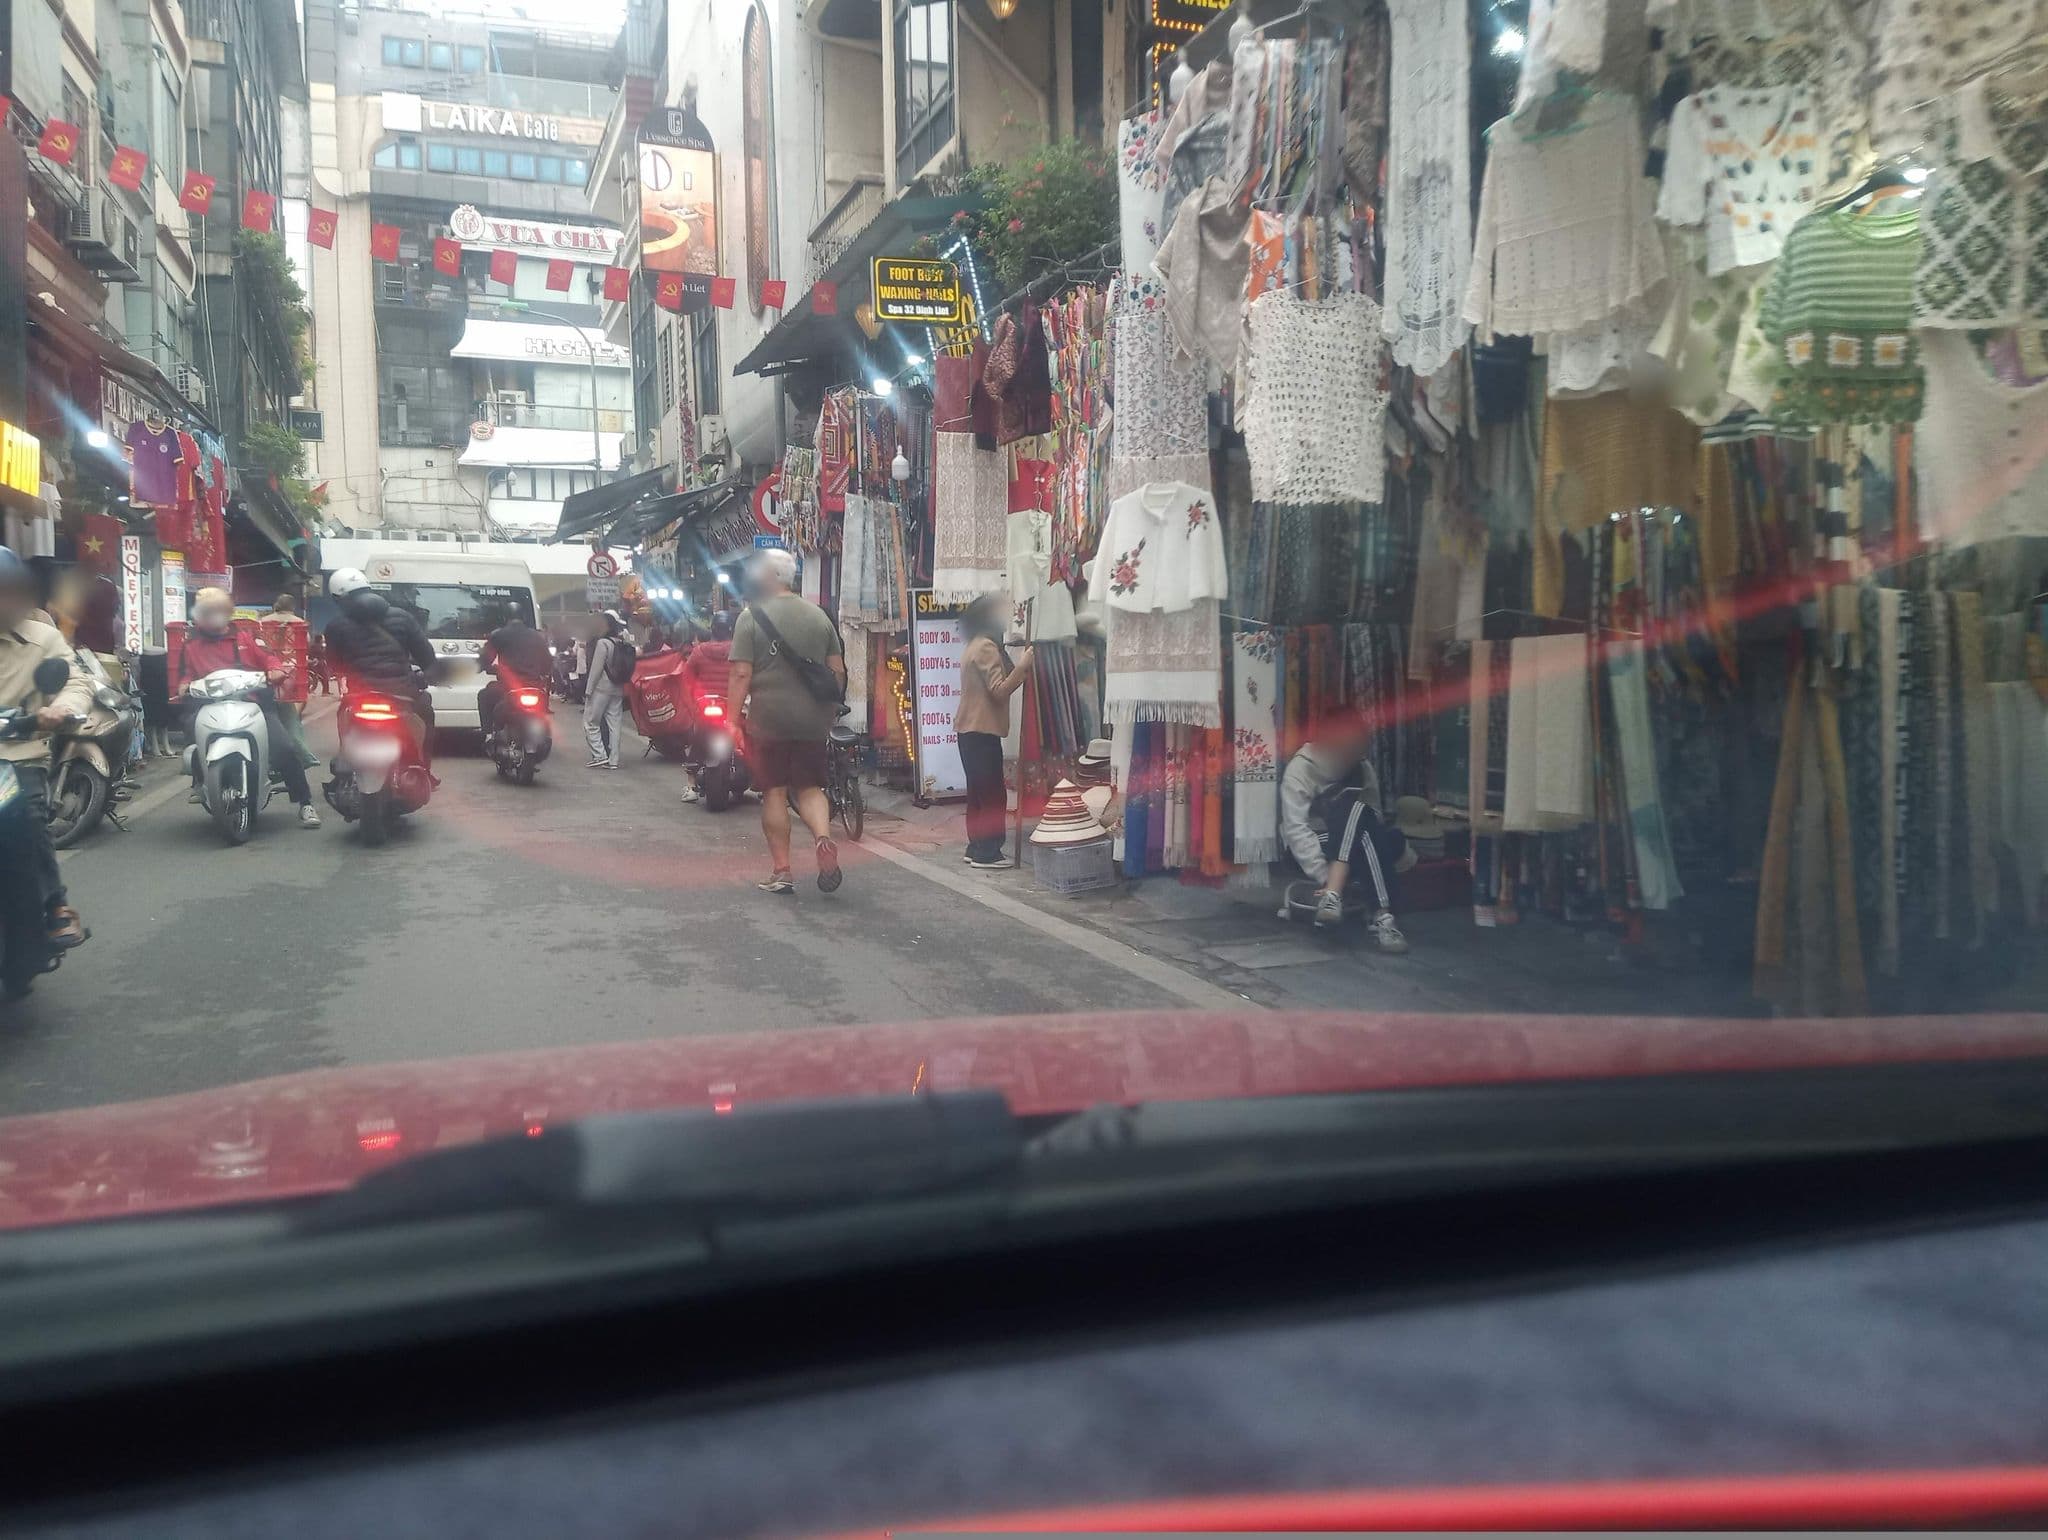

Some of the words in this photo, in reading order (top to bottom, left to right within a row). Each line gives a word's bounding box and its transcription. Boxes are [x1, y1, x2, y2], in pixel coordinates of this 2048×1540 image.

[428, 103, 519, 137] LAIKA
[688, 136, 706, 149] Spa
[491, 222, 547, 245] VUA
[889, 266, 914, 281] FOOT
[880, 285, 922, 301] WAXING
[925, 286, 954, 302] NAILS
[887, 303, 903, 315] Spa
[904, 304, 915, 315] 32
[124, 539, 138, 604] MONEY
[919, 631, 939, 645] BODY
[940, 631, 950, 644] 30
[920, 684, 938, 698] FOOT
[940, 684, 950, 697] 30
[923, 735, 941, 745] NAILS
